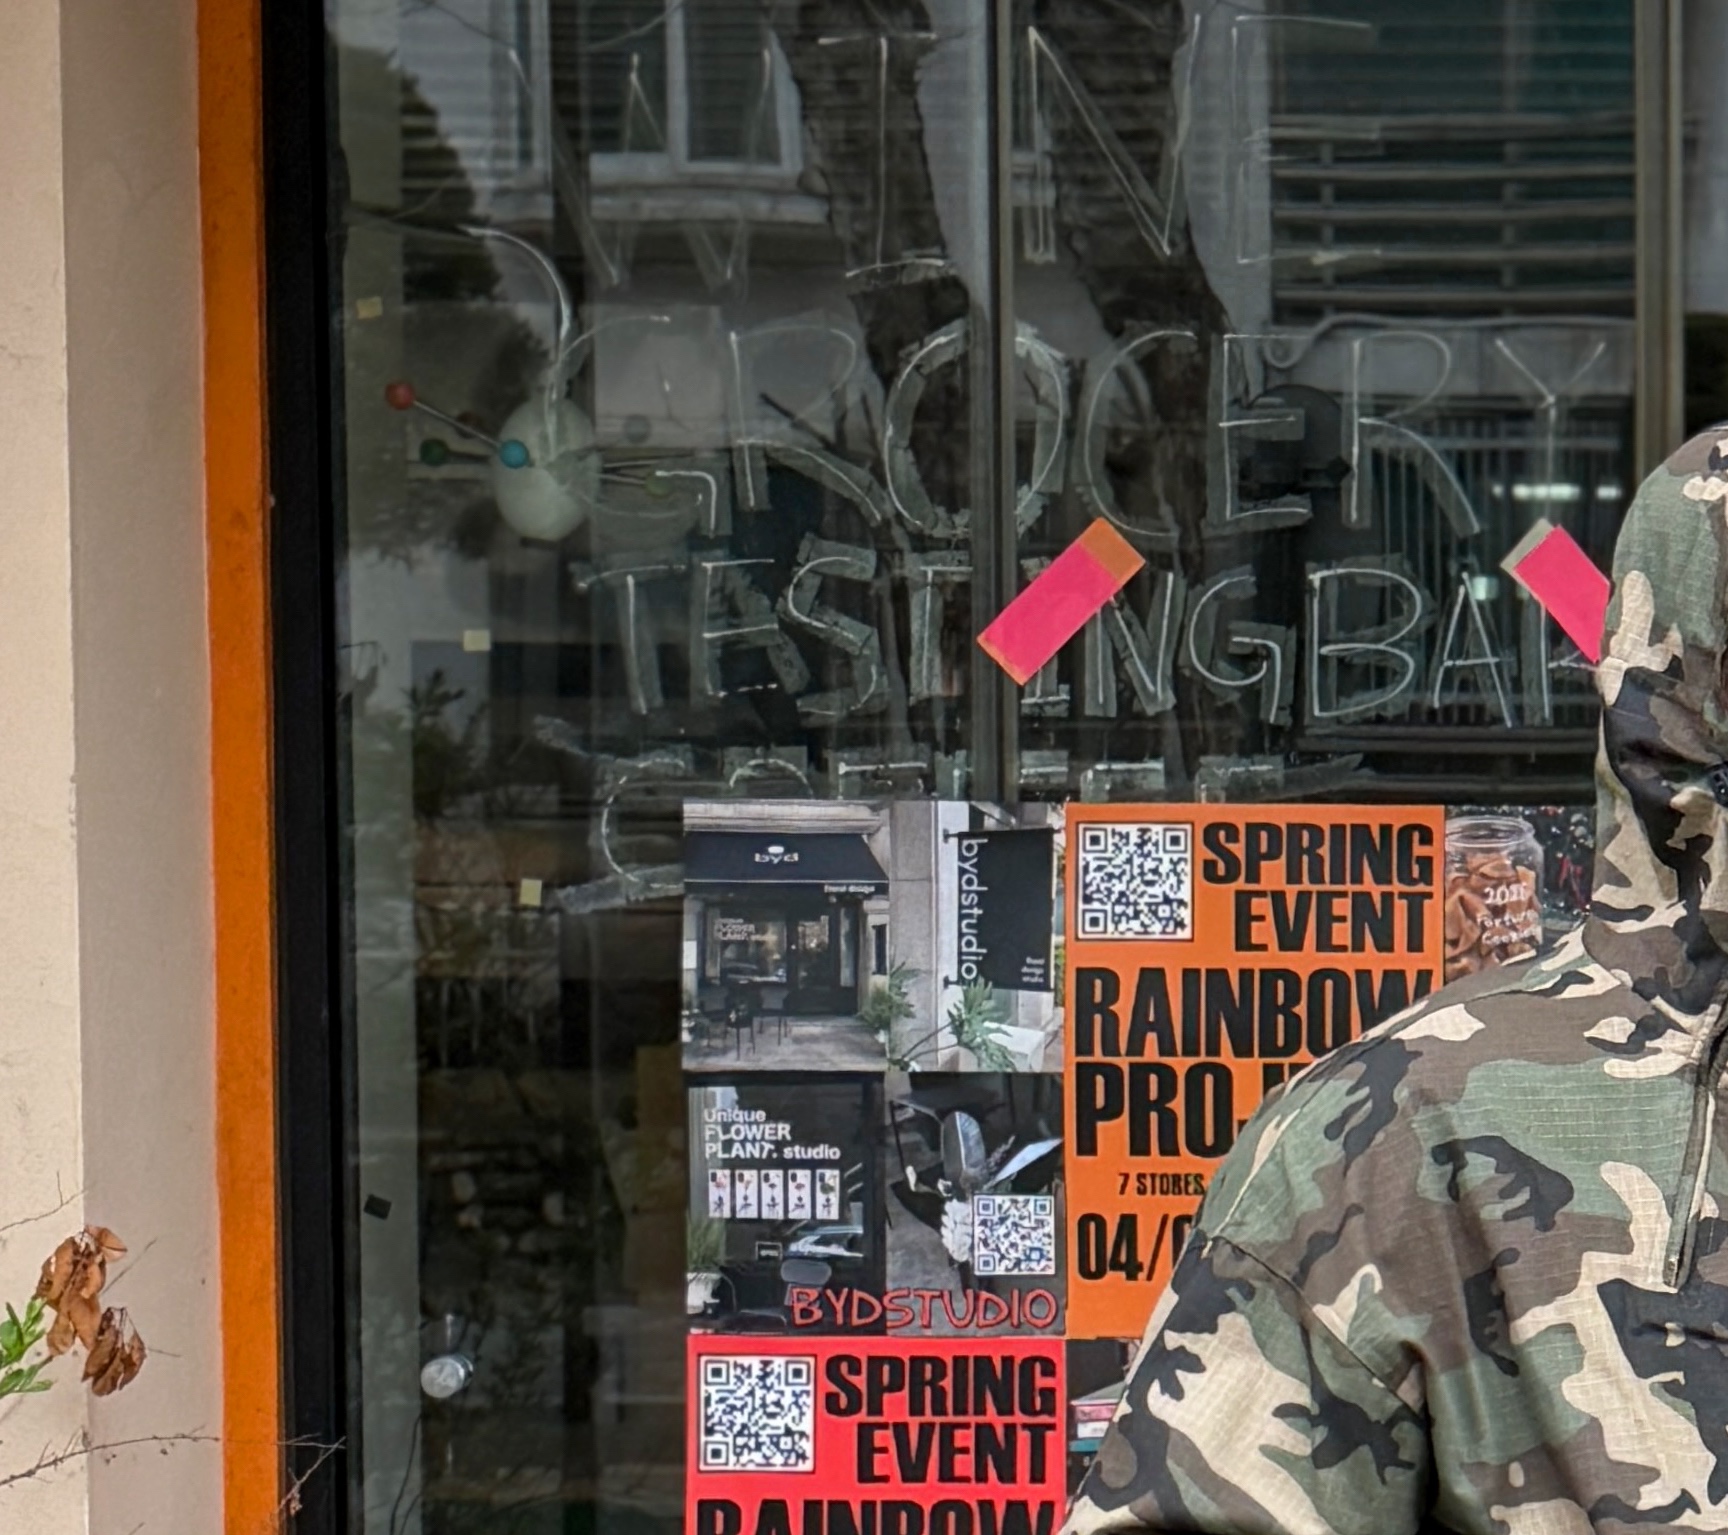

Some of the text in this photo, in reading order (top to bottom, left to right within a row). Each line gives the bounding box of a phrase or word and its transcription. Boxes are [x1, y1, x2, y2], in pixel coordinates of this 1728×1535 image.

[557, 316, 1606, 540] GROCERY
[1203, 822, 1433, 886] SPRING
[957, 838, 989, 980] bydstudio
[1235, 891, 1432, 953] EVENT
[703, 1108, 766, 1126] Unique
[704, 1123, 792, 1142] FLOWER
[782, 1143, 841, 1161] studio
[1118, 1173, 1130, 1195] 7
[790, 1287, 1059, 1330] BYDSTUDIO
[825, 1354, 1057, 1418] SPRING
[857, 1422, 1056, 1484] EVENT
